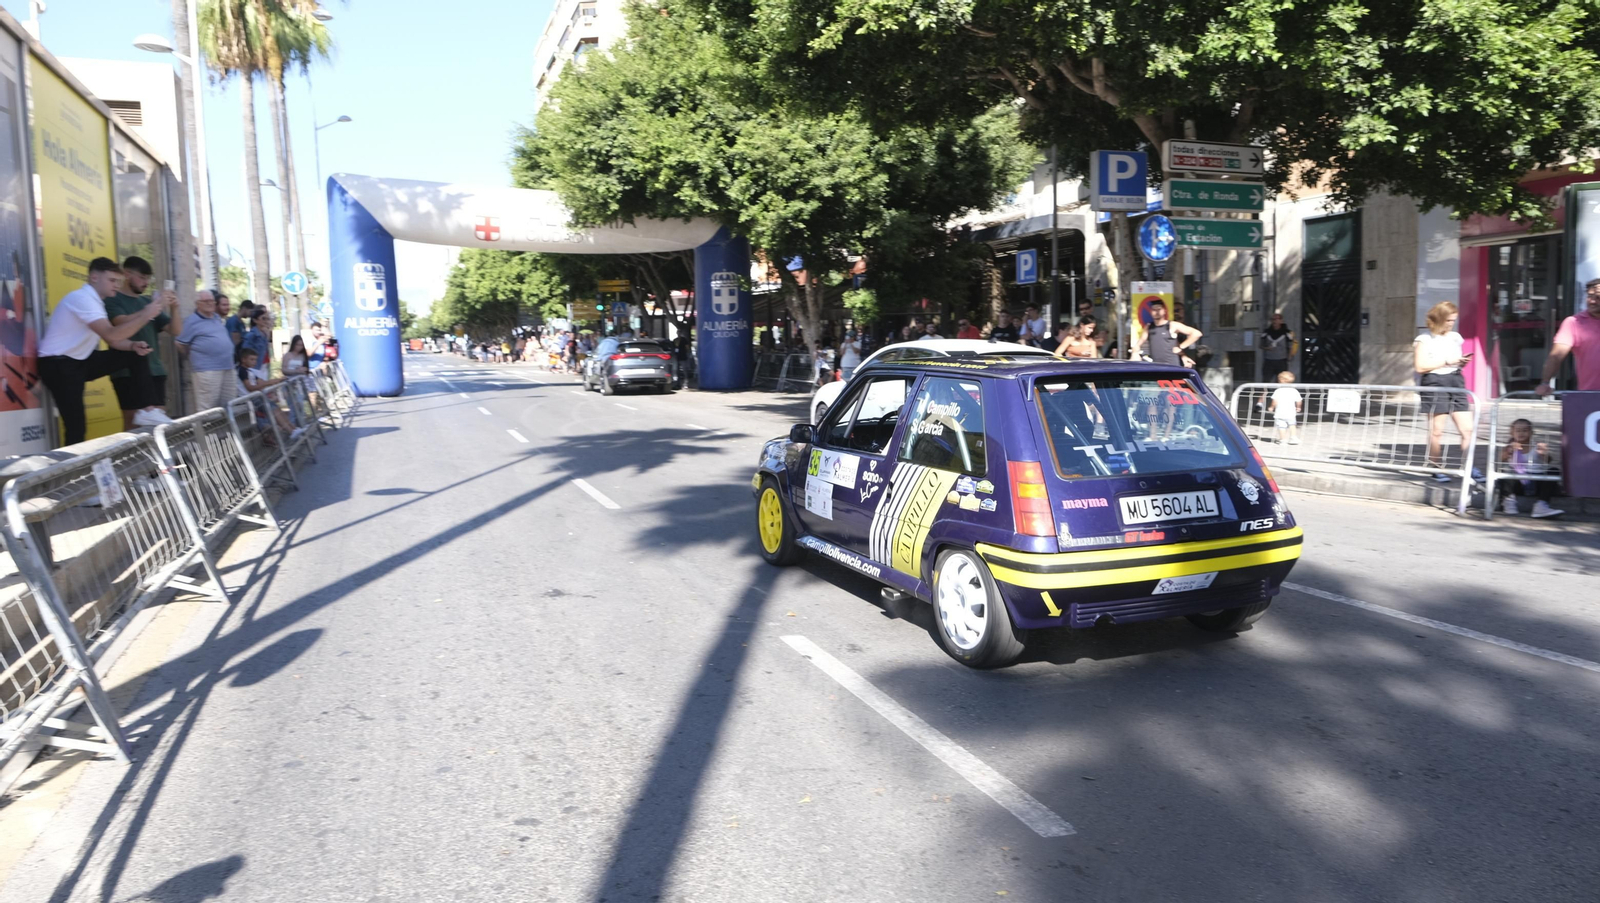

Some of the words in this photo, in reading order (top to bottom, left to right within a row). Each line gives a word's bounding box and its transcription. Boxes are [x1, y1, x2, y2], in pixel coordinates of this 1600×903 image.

[1173, 145, 1195, 154] todas
[1198, 147, 1239, 157] direcciones
[1108, 154, 1138, 193] P
[1172, 189, 1194, 199] Ctra.
[1198, 191, 1209, 200] de
[1213, 191, 1239, 201] Ronda
[1020, 253, 1033, 281] P
[702, 317, 749, 331] ALMERÍA
[1157, 379, 1200, 405] 35
[927, 399, 961, 419] Campillo
[918, 420, 944, 436] García
[808, 449, 823, 477] 35
[1062, 497, 1109, 510] mayma
[1126, 500, 1149, 519] MU
[1151, 496, 1192, 517] 5604
[1196, 494, 1214, 513] AL
[806, 538, 881, 578] campillolivencia.com
